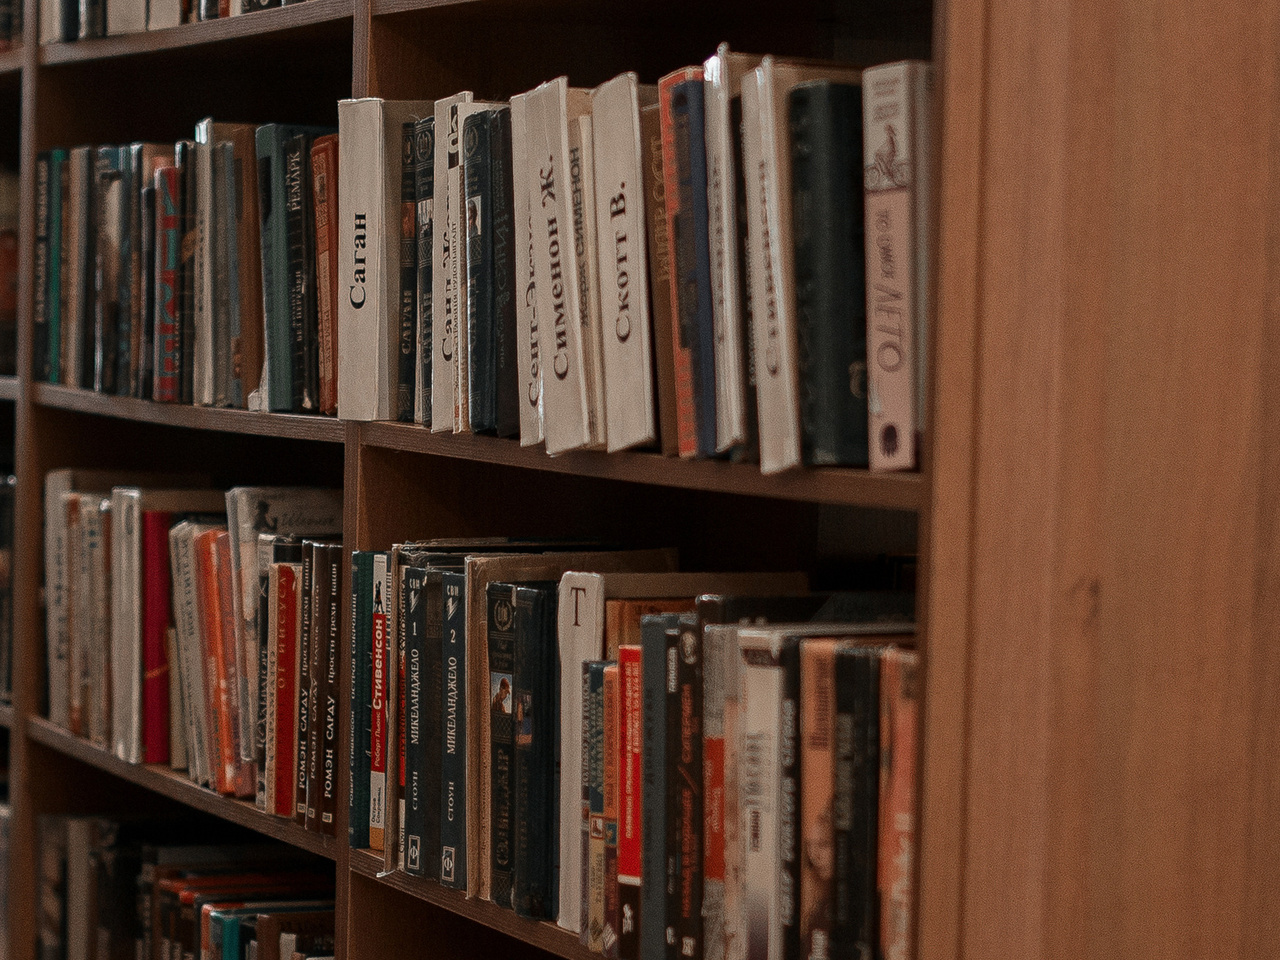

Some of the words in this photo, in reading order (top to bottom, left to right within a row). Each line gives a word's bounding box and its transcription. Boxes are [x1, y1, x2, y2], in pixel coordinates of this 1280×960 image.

[289, 152, 301, 211] РЕМАРК
[539, 153, 556, 207] Ж.
[569, 147, 585, 258] СИМЕНОН
[609, 181, 628, 219] В.
[350, 213, 367, 310] Саган
[546, 217, 570, 381] Сименон
[614, 231, 632, 343] Скотт
[401, 290, 413, 354] САГАН
[302, 596, 310, 630] грехи
[329, 602, 337, 636] грехи
[412, 621, 417, 636] 1
[569, 587, 586, 627] Т
[301, 633, 309, 677] Прости
[450, 628, 456, 643] 2
[327, 640, 336, 683] Прости
[373, 619, 383, 710] Стивенсон
[299, 687, 308, 732] САРДУ
[325, 694, 335, 741] САРДУ
[409, 647, 421, 745] МИКЕЛАНДЖЕЛО
[445, 655, 457, 755] МИКЕЛАНДЖЕЛО
[298, 740, 307, 789] РОМЭН
[324, 748, 333, 798] РОМЭН
[374, 738, 382, 767] Роберт
[411, 770, 419, 811] СТОУН
[446, 781, 455, 821] СТОУН
